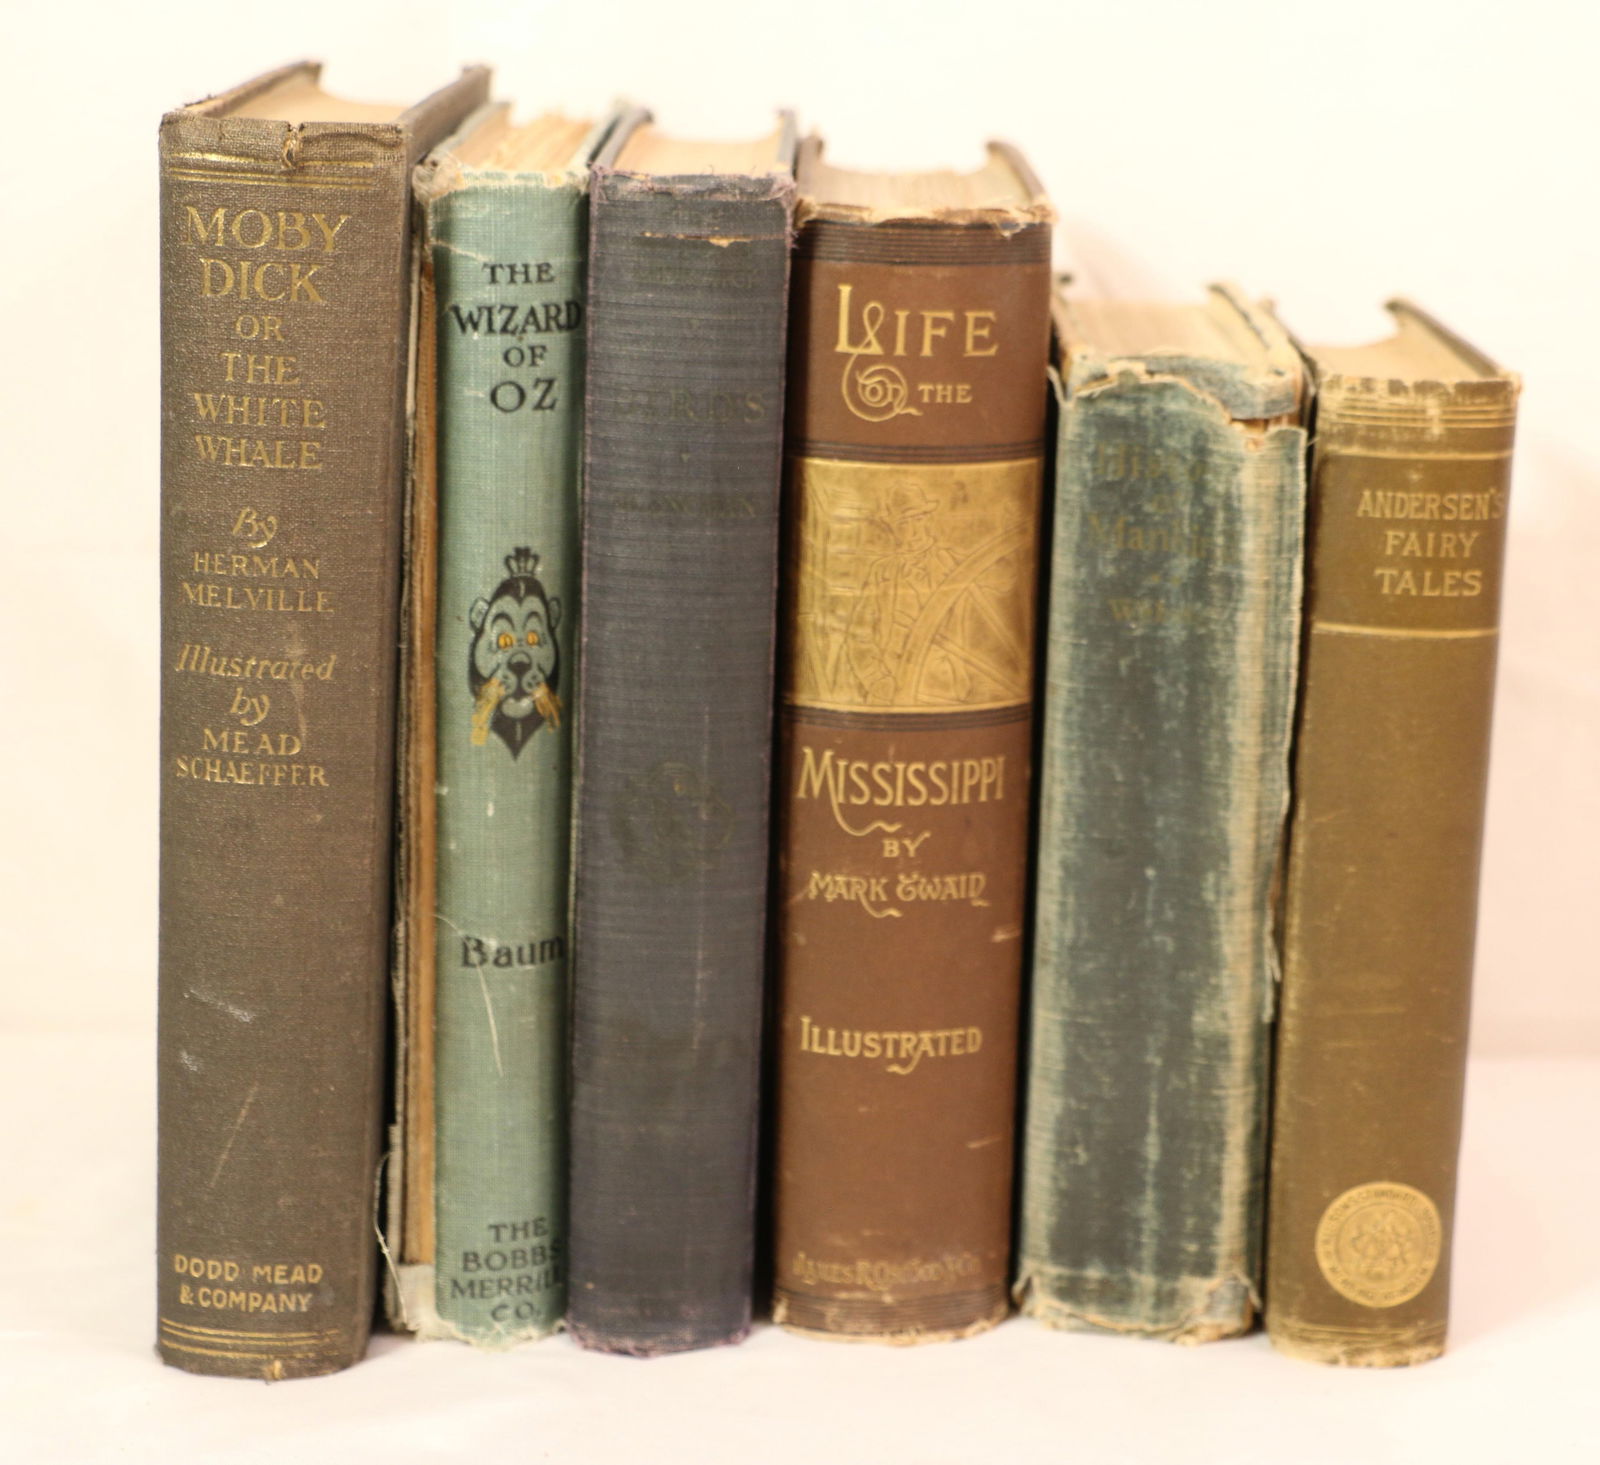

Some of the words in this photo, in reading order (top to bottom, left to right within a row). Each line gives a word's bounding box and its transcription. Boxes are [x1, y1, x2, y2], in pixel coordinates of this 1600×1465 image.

[181, 205, 352, 254] MOBY
[199, 257, 327, 303] DICK
[481, 262, 556, 285] THE
[235, 314, 285, 342] OR
[450, 300, 582, 336] WIZARD
[834, 283, 999, 357] LIFE
[220, 352, 300, 386] THE
[503, 344, 548, 368] OF
[194, 392, 326, 429] WHITE
[490, 376, 558, 414] OZ
[917, 383, 973, 404] THE
[194, 434, 323, 470] WHALE
[1356, 488, 1506, 521] ANDERSEN'S
[231, 506, 279, 549] By
[1384, 530, 1480, 558] FAIRY
[193, 551, 322, 579] HERMAN
[1373, 567, 1483, 597] TALES
[181, 581, 336, 614] MELVILLE
[175, 642, 338, 682] Illustrated
[230, 687, 271, 727] by
[203, 727, 302, 757] MEAD
[175, 754, 330, 788] SCHAEFFER
[797, 746, 1006, 837] MISSISSIPPI
[882, 831, 931, 858] BY
[807, 870, 902, 918] MARK
[461, 935, 567, 969] Baum
[799, 1015, 984, 1076] ILLUSTRATED
[488, 1216, 550, 1244] THE
[174, 1254, 240, 1283] DODD
[252, 1263, 324, 1286] MEAD
[179, 1284, 194, 1305] &
[198, 1287, 313, 1313] COMPANY
